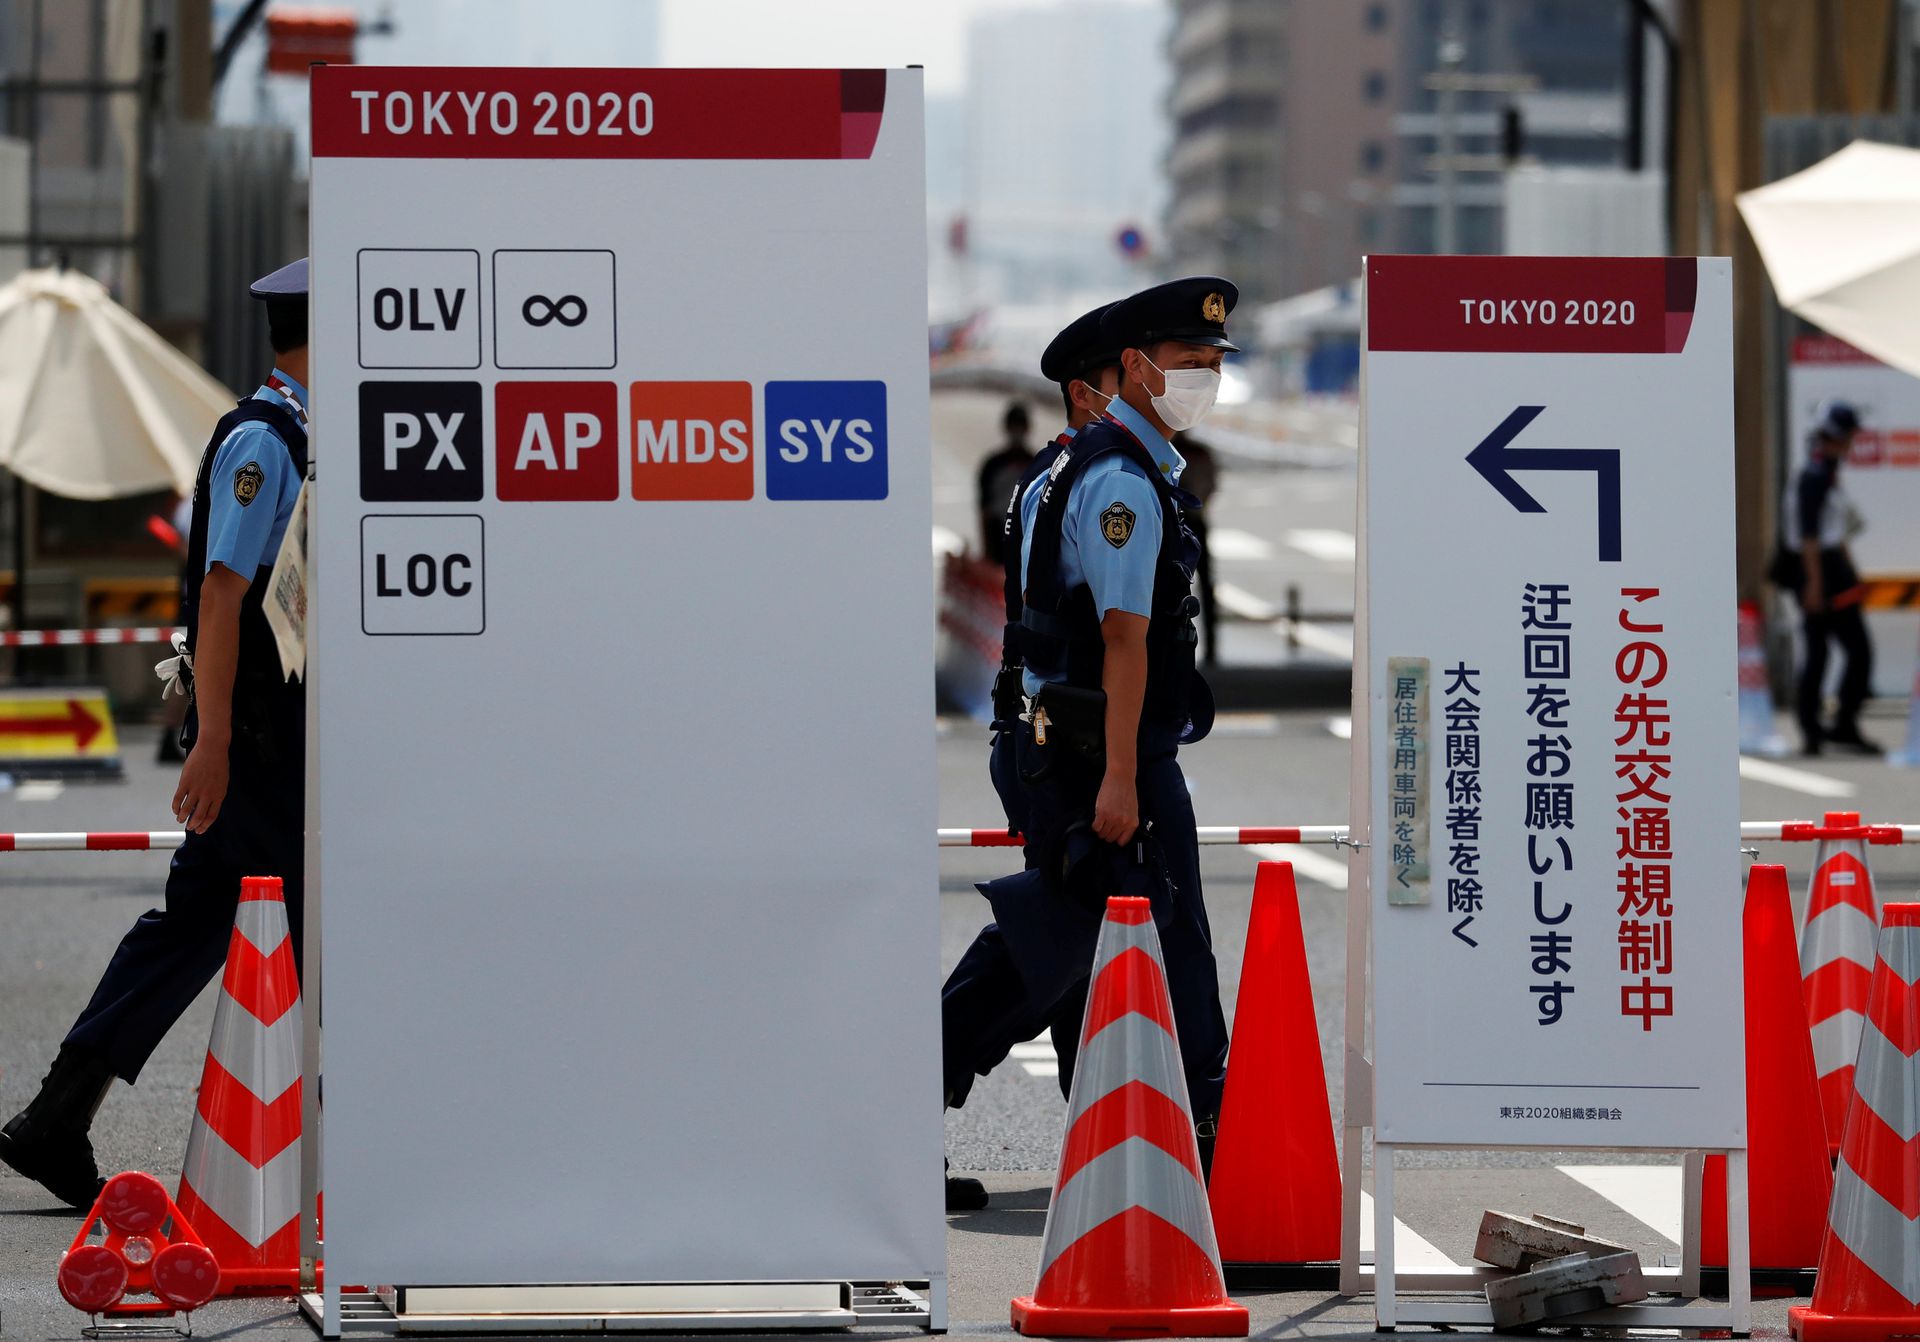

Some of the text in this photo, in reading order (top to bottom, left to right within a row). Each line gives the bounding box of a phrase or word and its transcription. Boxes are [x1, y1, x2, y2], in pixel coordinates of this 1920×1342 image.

[351, 91, 654, 136] TOKYO 2020
[373, 288, 465, 331] OLV
[1460, 299, 1635, 325] TOKYO 2020
[383, 412, 465, 470] PX
[515, 412, 601, 470] AP
[637, 420, 748, 464] MDS
[780, 419, 874, 463] SYS
[377, 553, 472, 597] LOC
[1393, 677, 1418, 889] 居住者用車両を除く
[1444, 661, 1484, 948] 大会関係者を除く
[1521, 583, 1575, 1026] 迂回をお願いします
[1614, 587, 1674, 1032] この先交通規制中
[1500, 1106, 1623, 1121] 東京2020組織委員会
